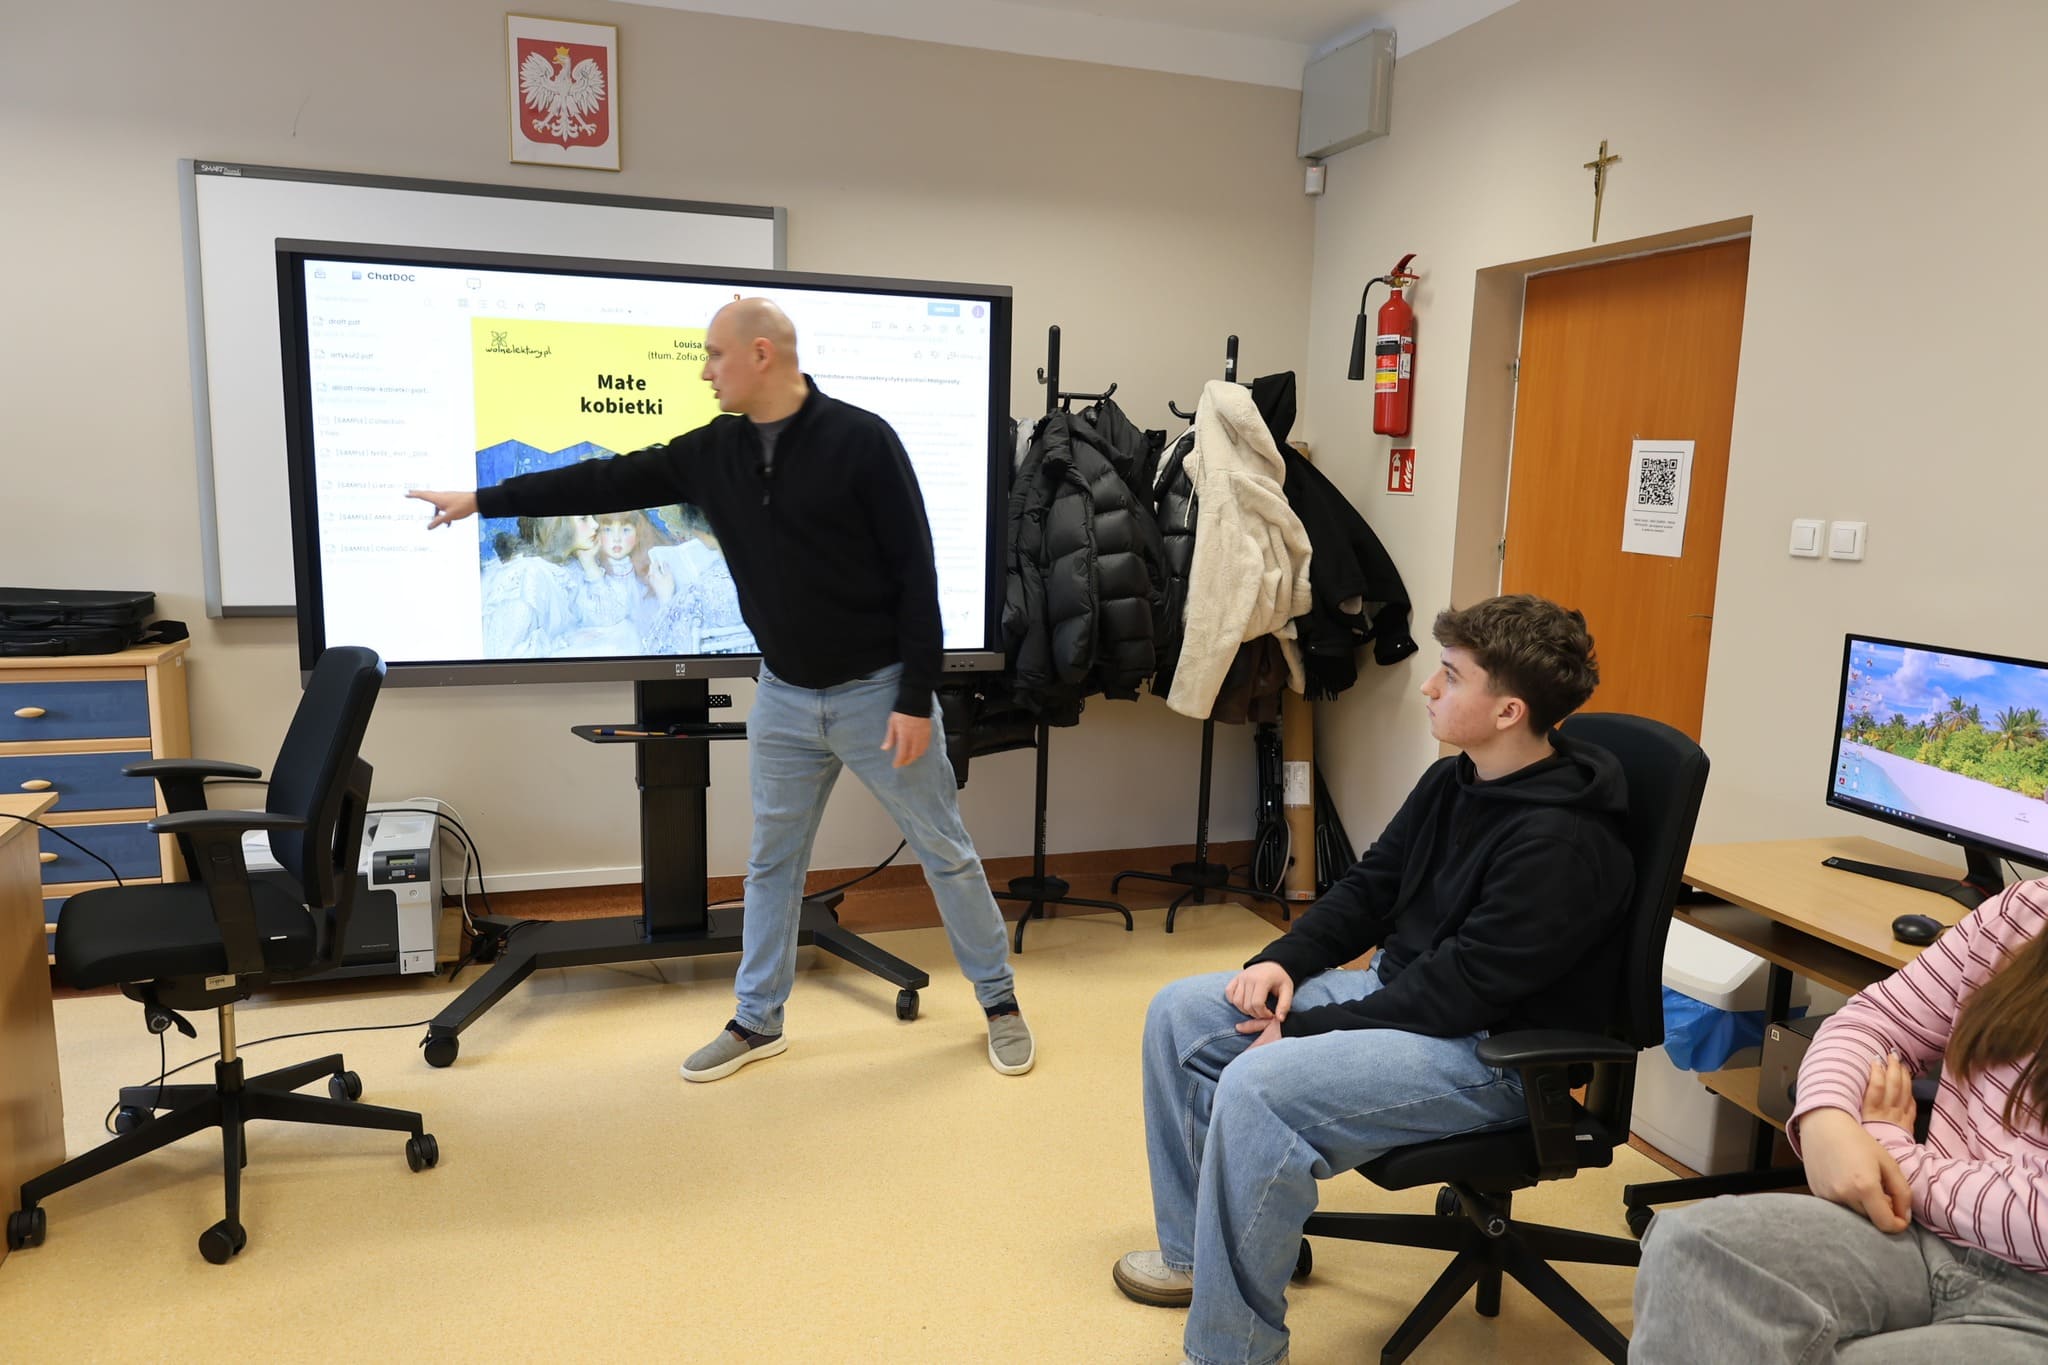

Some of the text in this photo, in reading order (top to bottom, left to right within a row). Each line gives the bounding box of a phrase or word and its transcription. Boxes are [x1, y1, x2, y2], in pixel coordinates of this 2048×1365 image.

[367, 271, 416, 282] ChatDOC
[674, 340, 702, 349] Louisa
[676, 352, 698, 361] Zofia
[597, 374, 646, 390] Małe
[580, 396, 663, 415] kobietki
